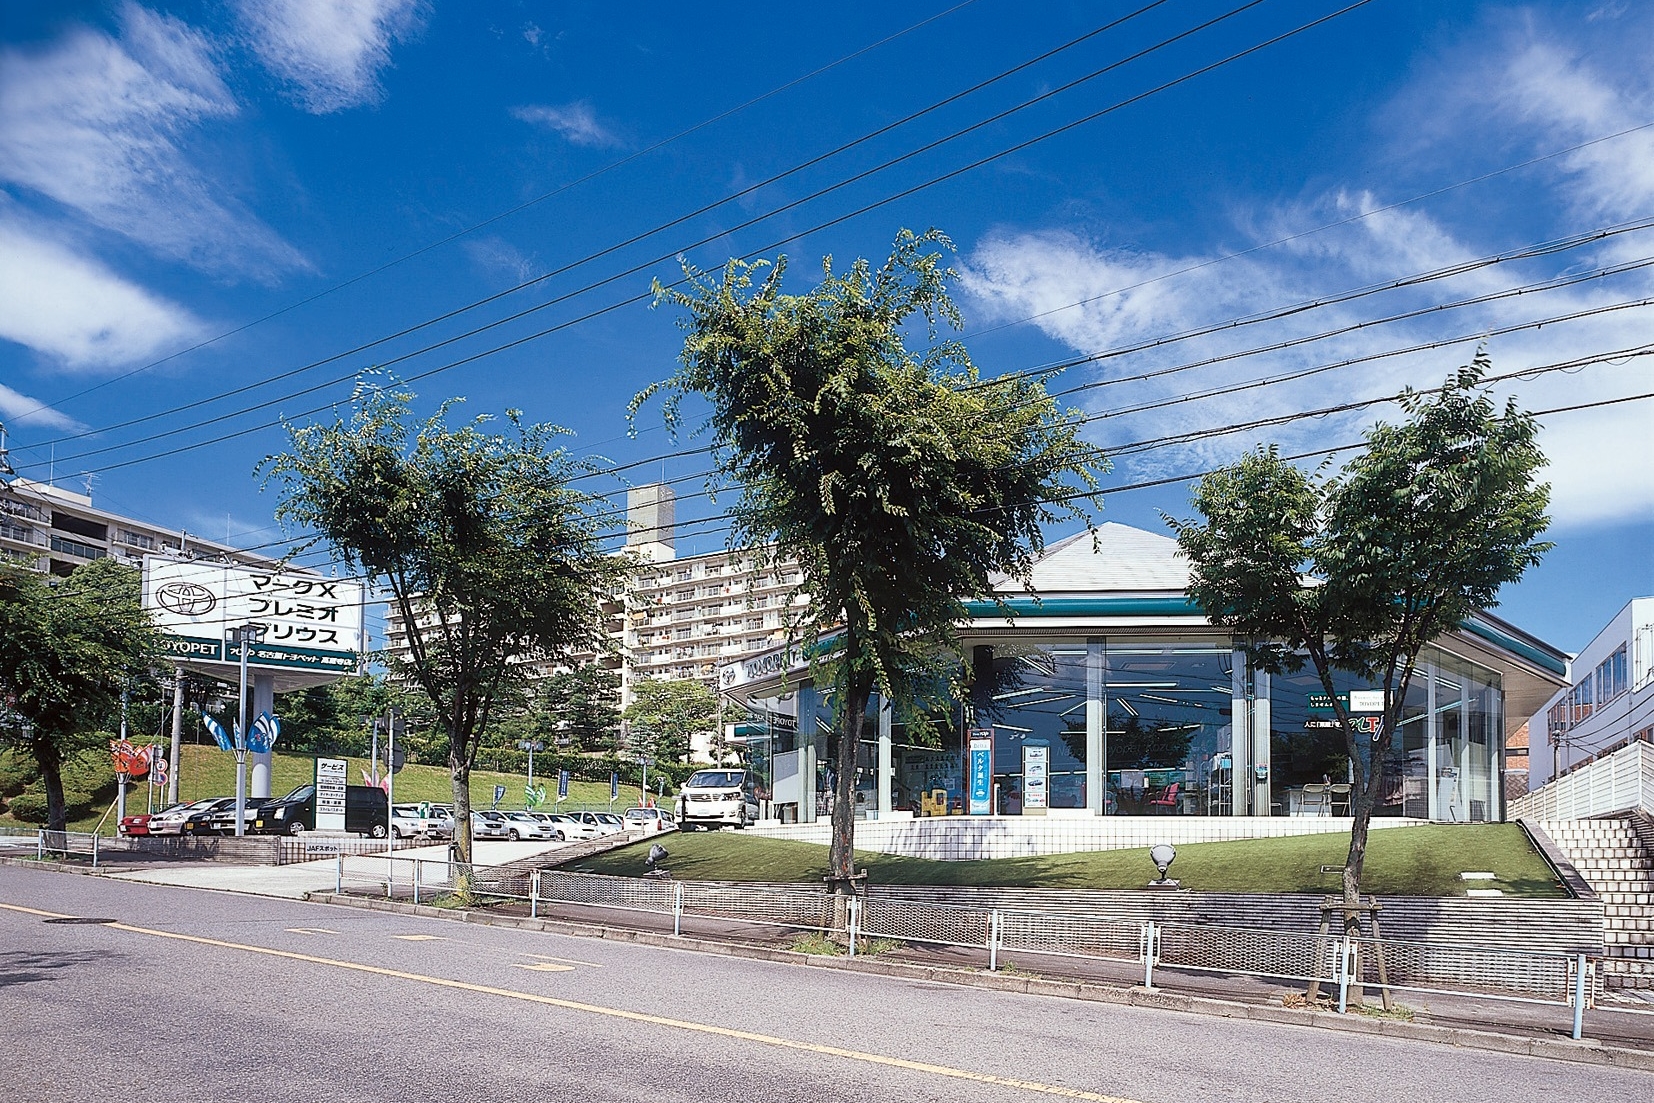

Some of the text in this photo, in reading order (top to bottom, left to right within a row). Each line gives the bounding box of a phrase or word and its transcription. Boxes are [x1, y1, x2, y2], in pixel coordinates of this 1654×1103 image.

[250, 574, 338, 599] マークX
[249, 598, 338, 622] プレミオ
[257, 650, 319, 663] 名古屋トヨペット
[321, 762, 344, 771] サービス
